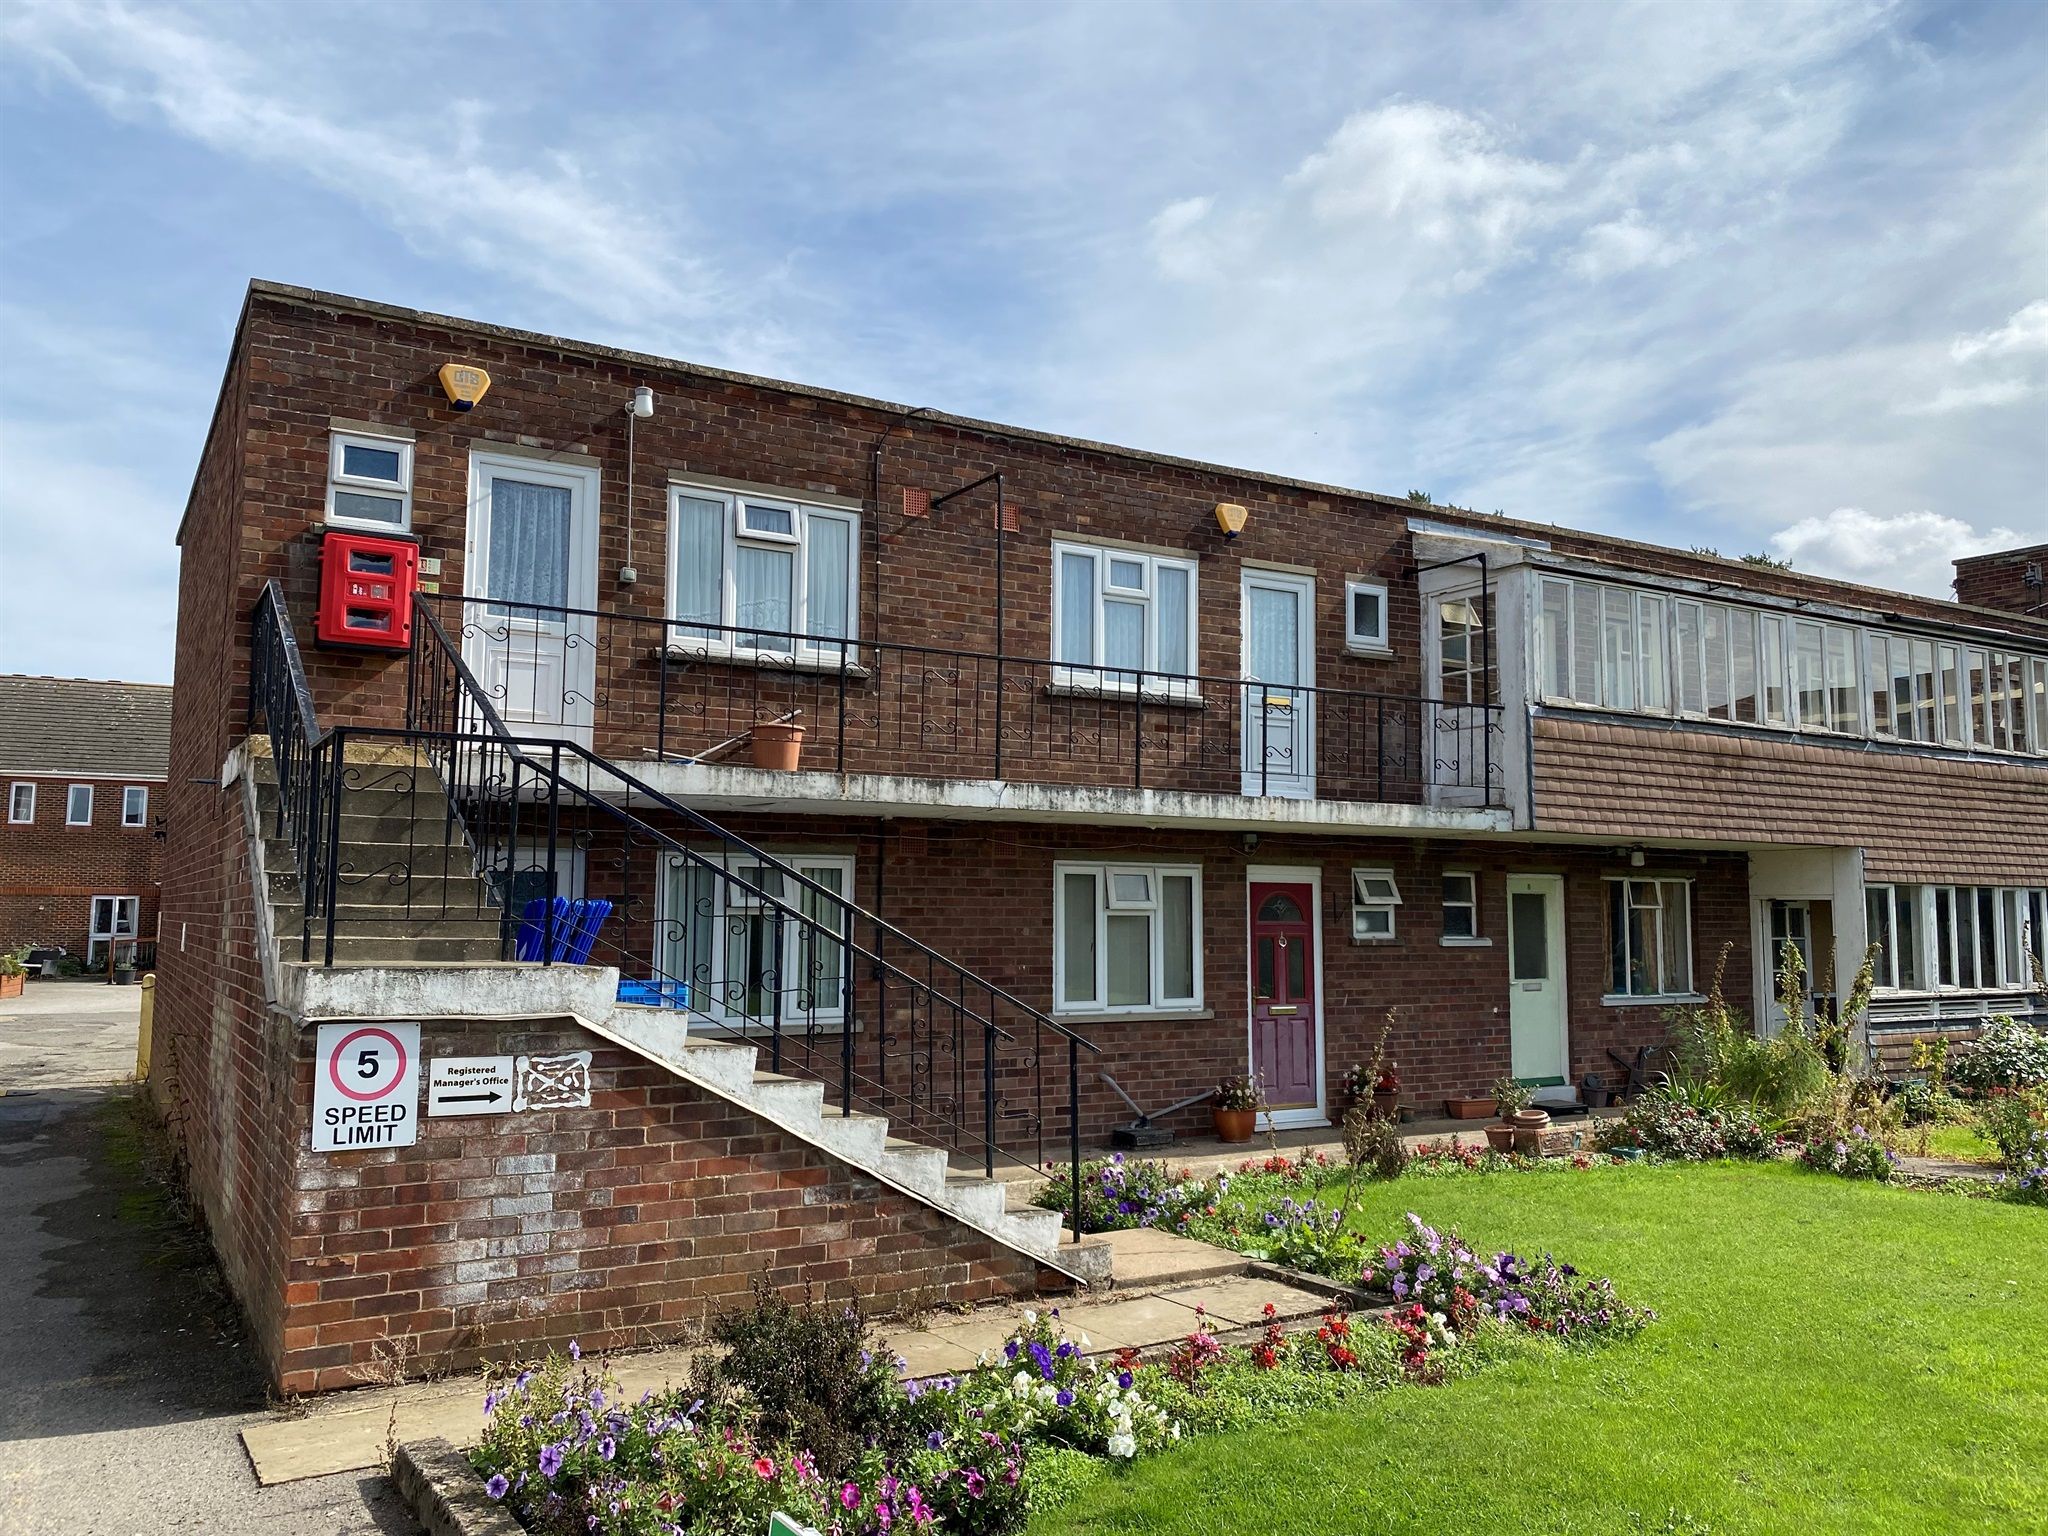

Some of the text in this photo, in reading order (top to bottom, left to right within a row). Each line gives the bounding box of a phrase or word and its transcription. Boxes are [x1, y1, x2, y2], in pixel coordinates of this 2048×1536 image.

[357, 1050, 379, 1079] 5
[447, 1066, 497, 1076] Registered
[433, 1077, 509, 1088] Manager's Office
[324, 1104, 407, 1126] SPEED
[332, 1124, 399, 1145] LIMIT
